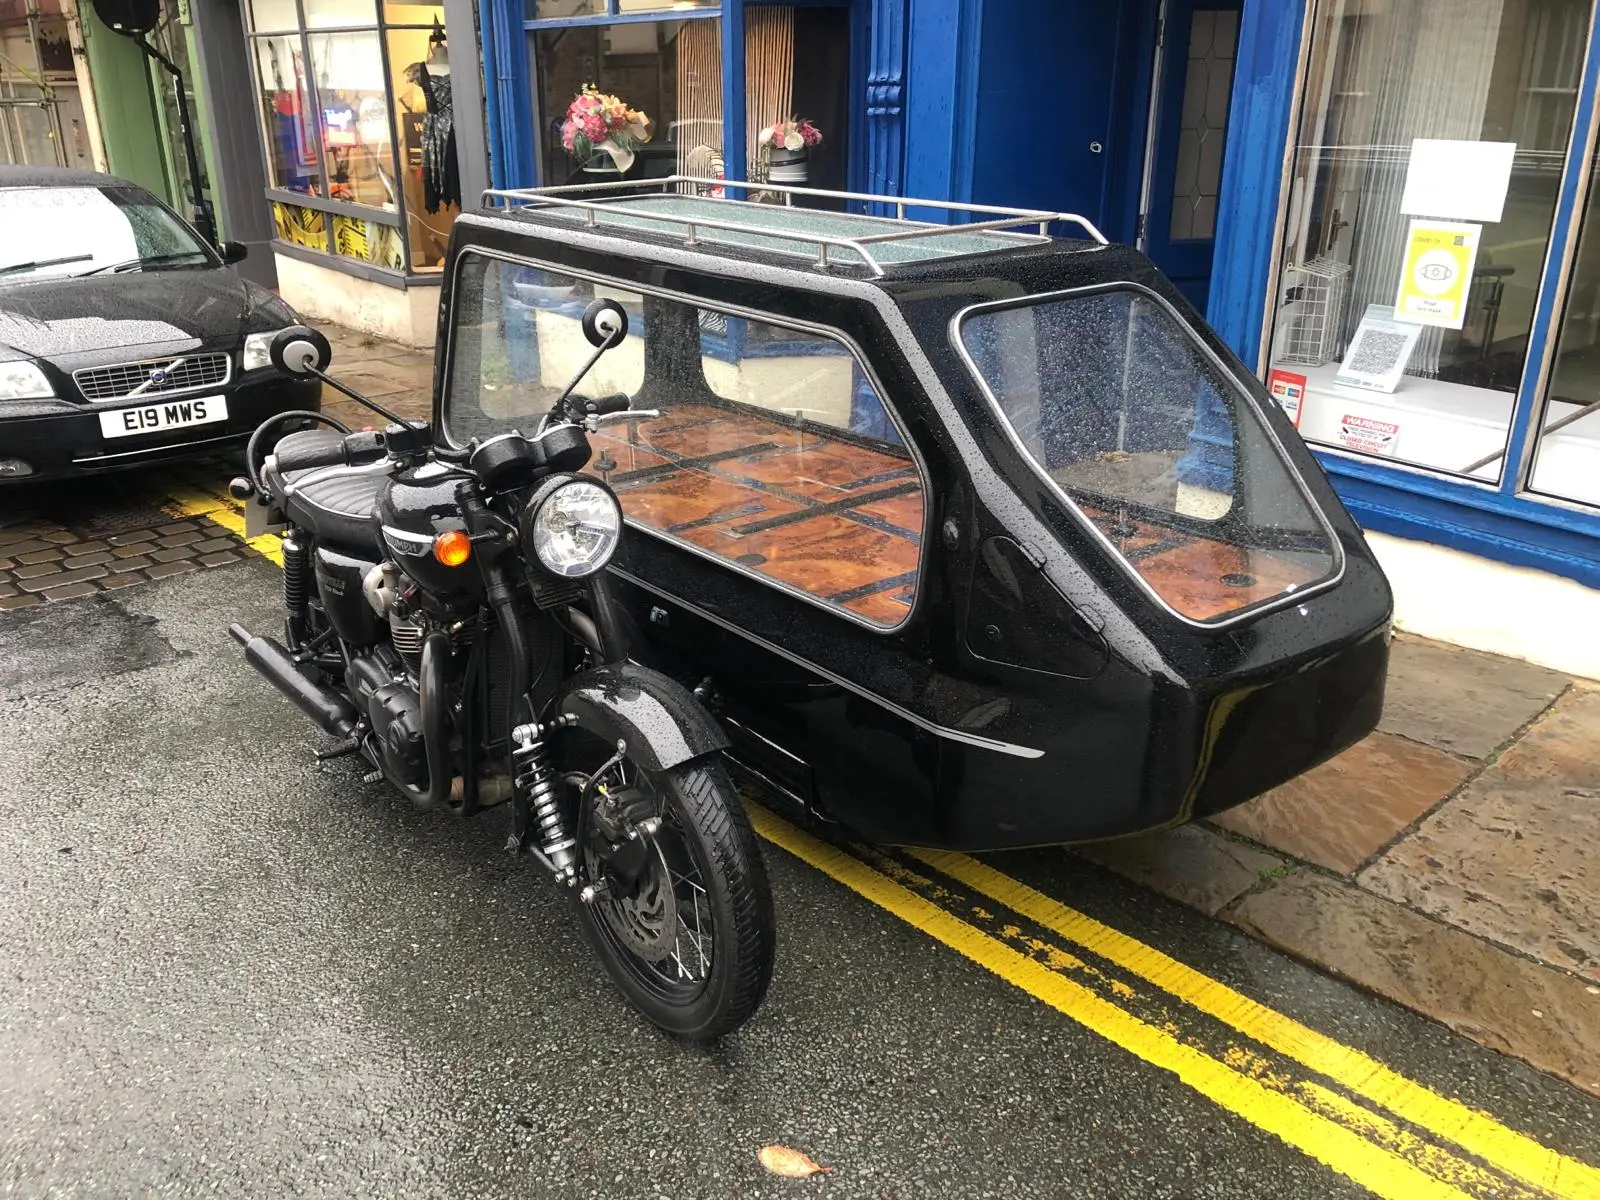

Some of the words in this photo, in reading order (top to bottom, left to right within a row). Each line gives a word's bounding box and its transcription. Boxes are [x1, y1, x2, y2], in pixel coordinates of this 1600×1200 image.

[122, 408, 159, 431] E19
[164, 401, 207, 424] MWS
[1346, 416, 1395, 433] WARNING
[1339, 434, 1362, 444] CLOSED
[1363, 438, 1388, 449] CIRCUIT
